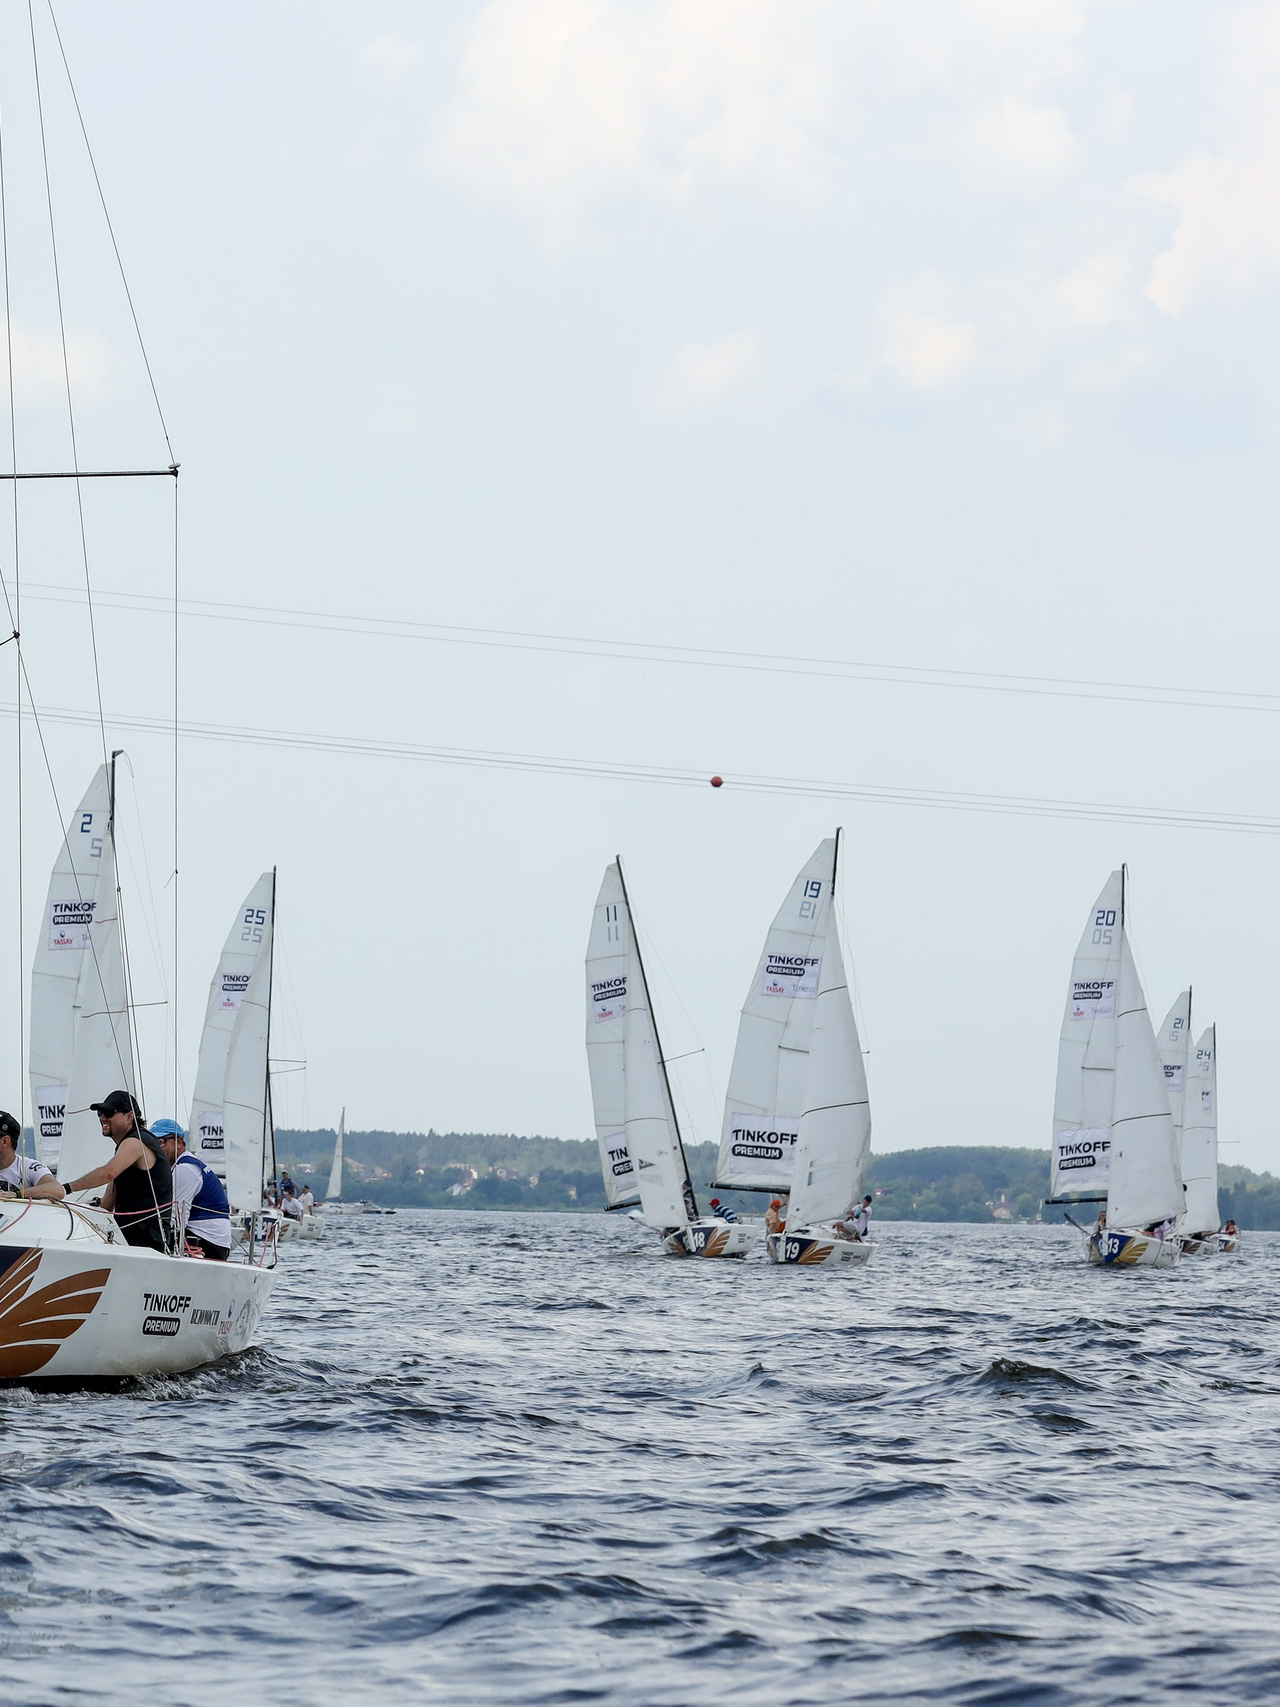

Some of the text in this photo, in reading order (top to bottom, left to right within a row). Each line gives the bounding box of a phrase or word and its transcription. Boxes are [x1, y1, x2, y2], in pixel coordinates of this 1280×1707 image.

[81, 813, 93, 833] 2
[803, 880, 822, 899] 19
[54, 916, 91, 924] PREMIUM
[244, 908, 266, 925] 25
[1095, 910, 1116, 927] 20
[768, 955, 819, 967] TINKOFF
[767, 966, 804, 976] PREMIUM
[223, 975, 251, 983] TINKO
[1074, 982, 1114, 990] TINKOFF
[1173, 1018, 1184, 1030] 21
[1197, 1050, 1211, 1060] 24
[732, 1129, 798, 1145] TINKOFF
[734, 1146, 780, 1157] PREMIUM
[1059, 1141, 1111, 1156] TINKOFF
[1060, 1157, 1094, 1169] PREMIUM
[693, 1231, 705, 1248] 18
[1108, 1238, 1120, 1254] 13
[786, 1241, 800, 1259] 19
[143, 1293, 191, 1313] TINKOFF
[144, 1319, 180, 1333] PREMIUM
